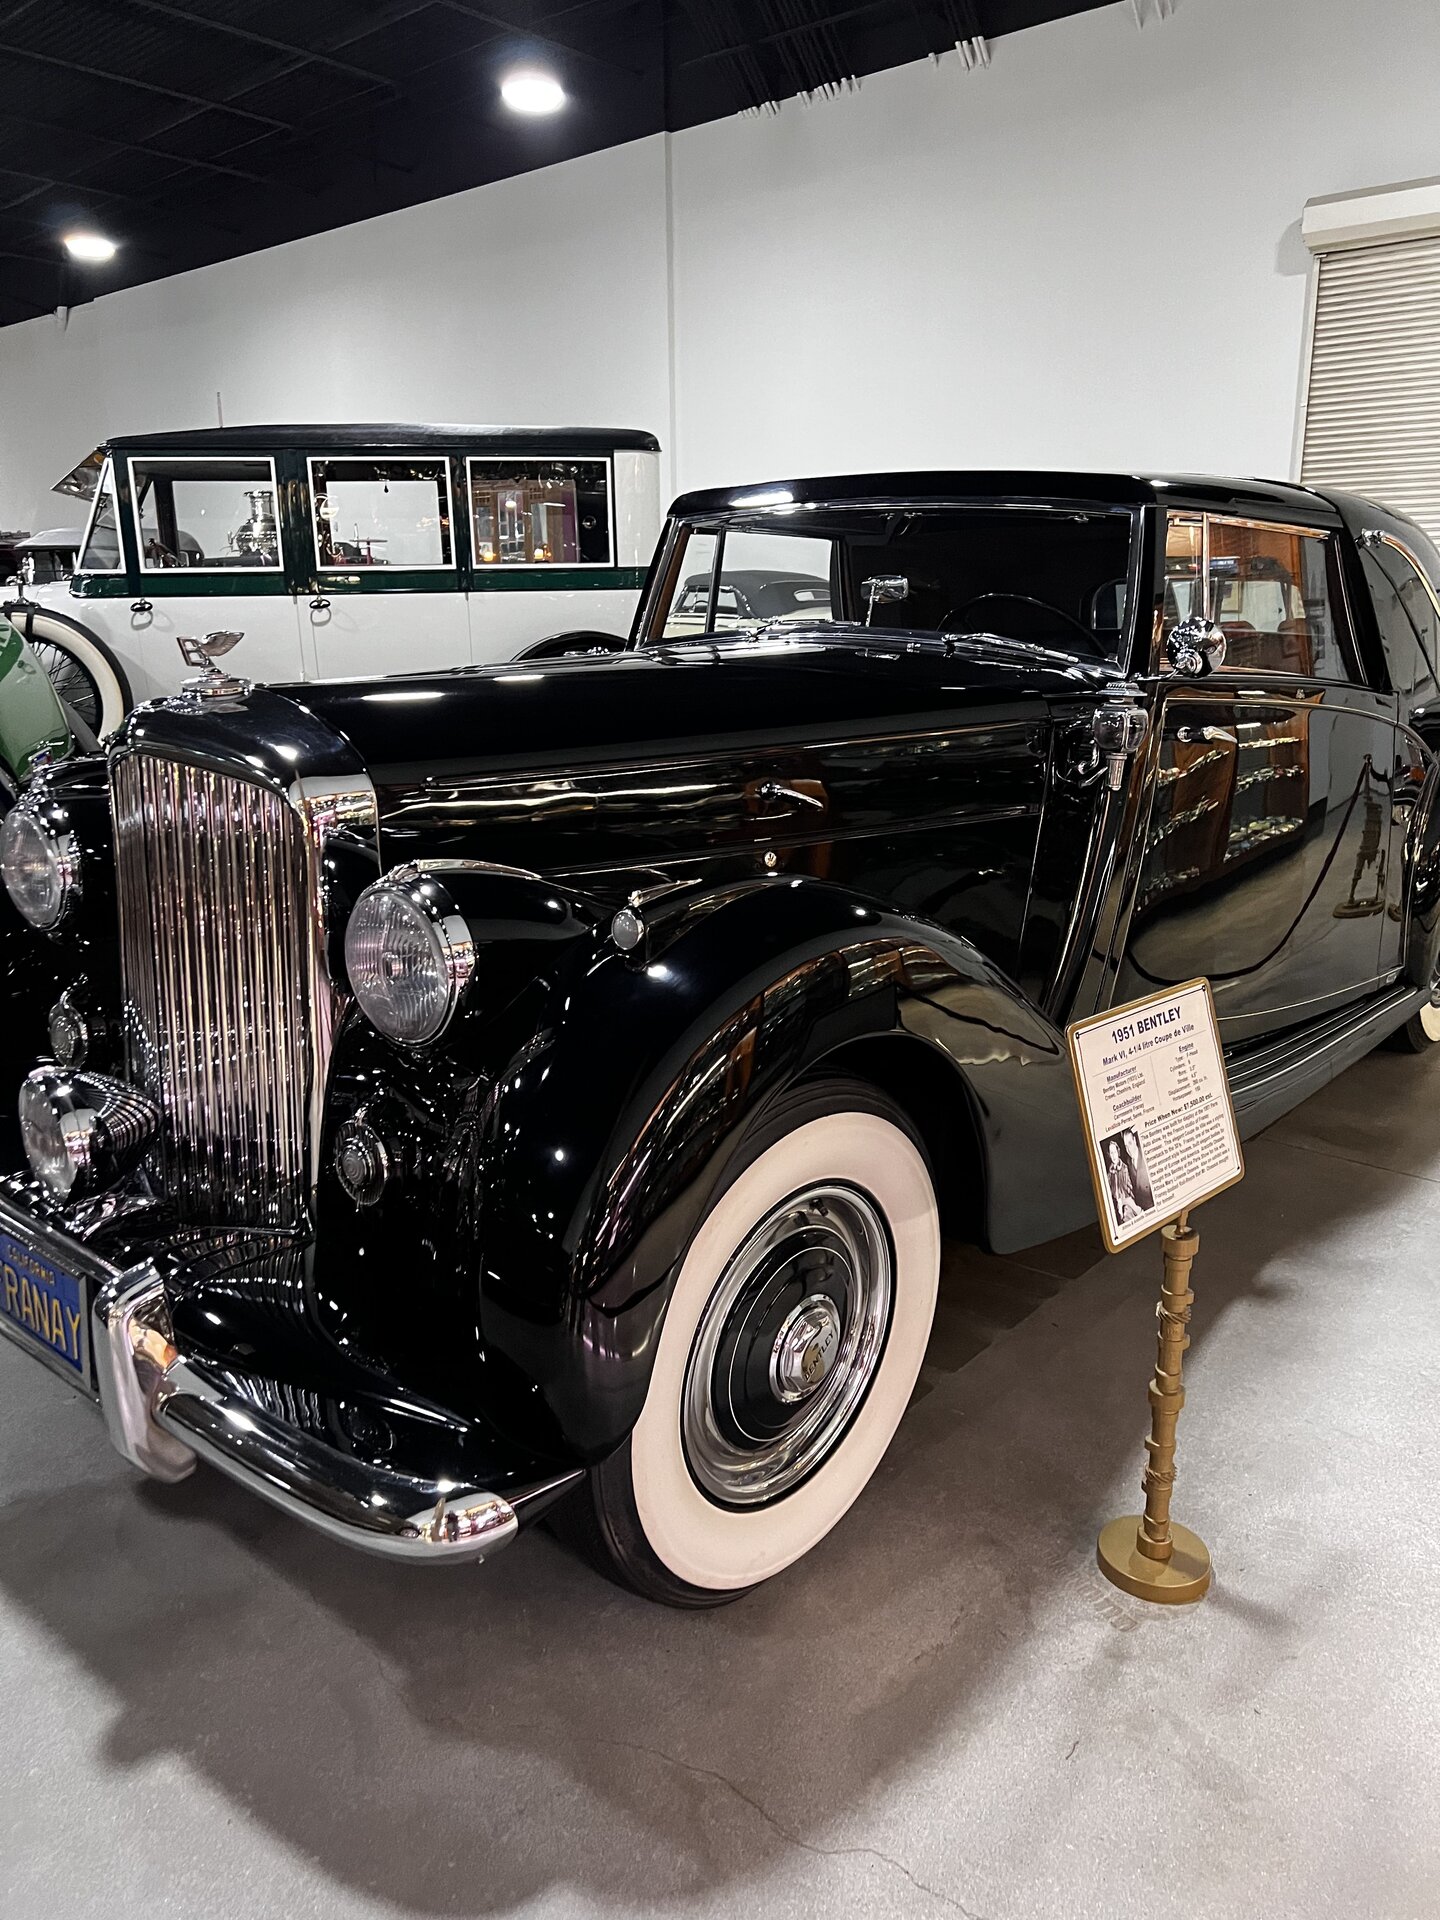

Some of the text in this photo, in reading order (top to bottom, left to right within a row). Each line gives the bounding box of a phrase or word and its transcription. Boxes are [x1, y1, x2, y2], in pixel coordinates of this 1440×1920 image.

[1111, 1006, 1182, 1044] 1951 BENTLEY
[1103, 1053, 1118, 1067] Mark
[1119, 1049, 1127, 1061] VI,
[1142, 1039, 1153, 1050] litre
[1154, 1031, 1173, 1046] Coupe
[1173, 1028, 1181, 1037] de
[1182, 1022, 1195, 1034] Ville
[1179, 1041, 1194, 1054] Engine
[1106, 1065, 1137, 1084] Manufacturer
[1112, 1092, 1142, 1112] Coachbuilder
[1144, 1117, 1157, 1128] Price
[1157, 1111, 1170, 1123] When
[1171, 1105, 1183, 1116] New:
[0, 1260, 81, 1360] RANAY
[804, 1332, 834, 1383] BENTLEY
